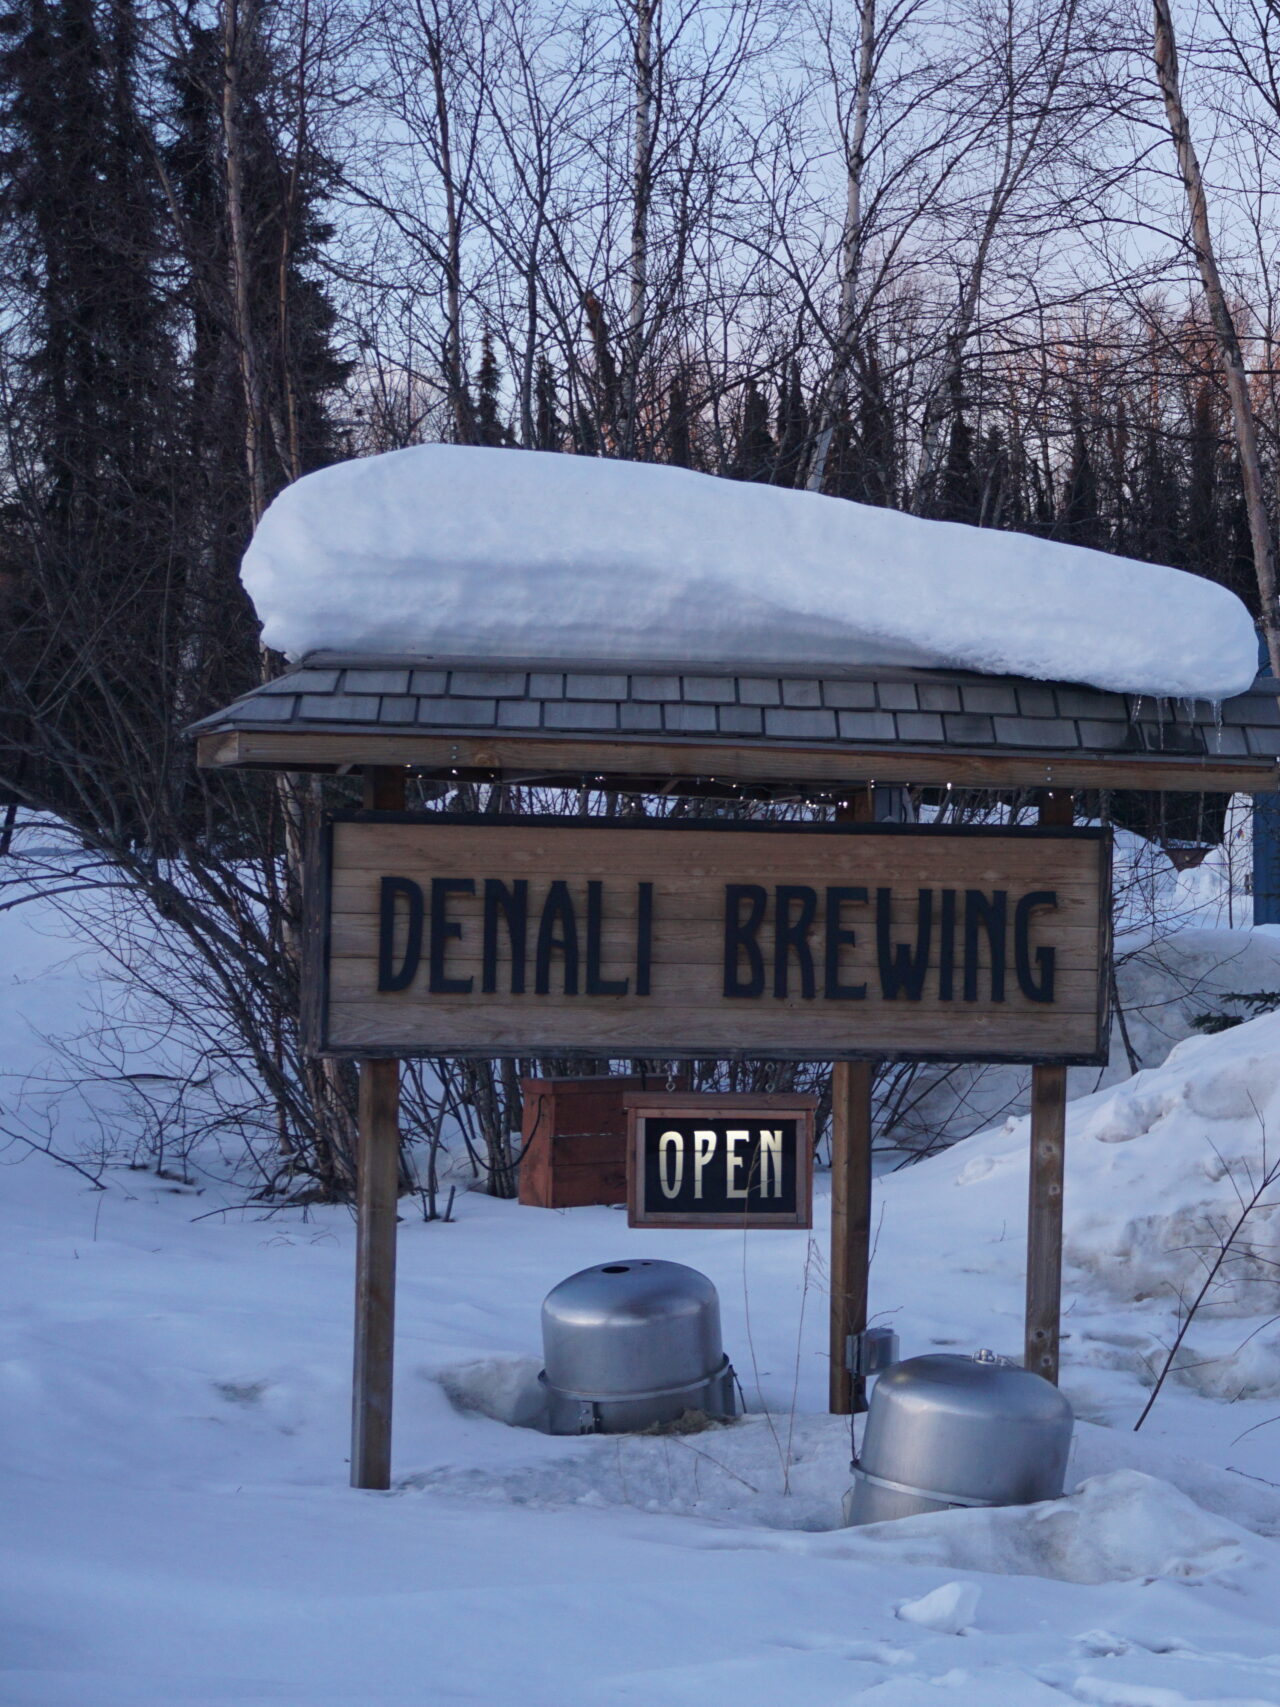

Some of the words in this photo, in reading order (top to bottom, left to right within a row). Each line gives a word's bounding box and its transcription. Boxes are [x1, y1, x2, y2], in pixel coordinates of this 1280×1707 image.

[378, 876, 653, 997] DENALI
[723, 884, 1058, 1003] BREWING
[659, 1129, 783, 1199] OPEN
